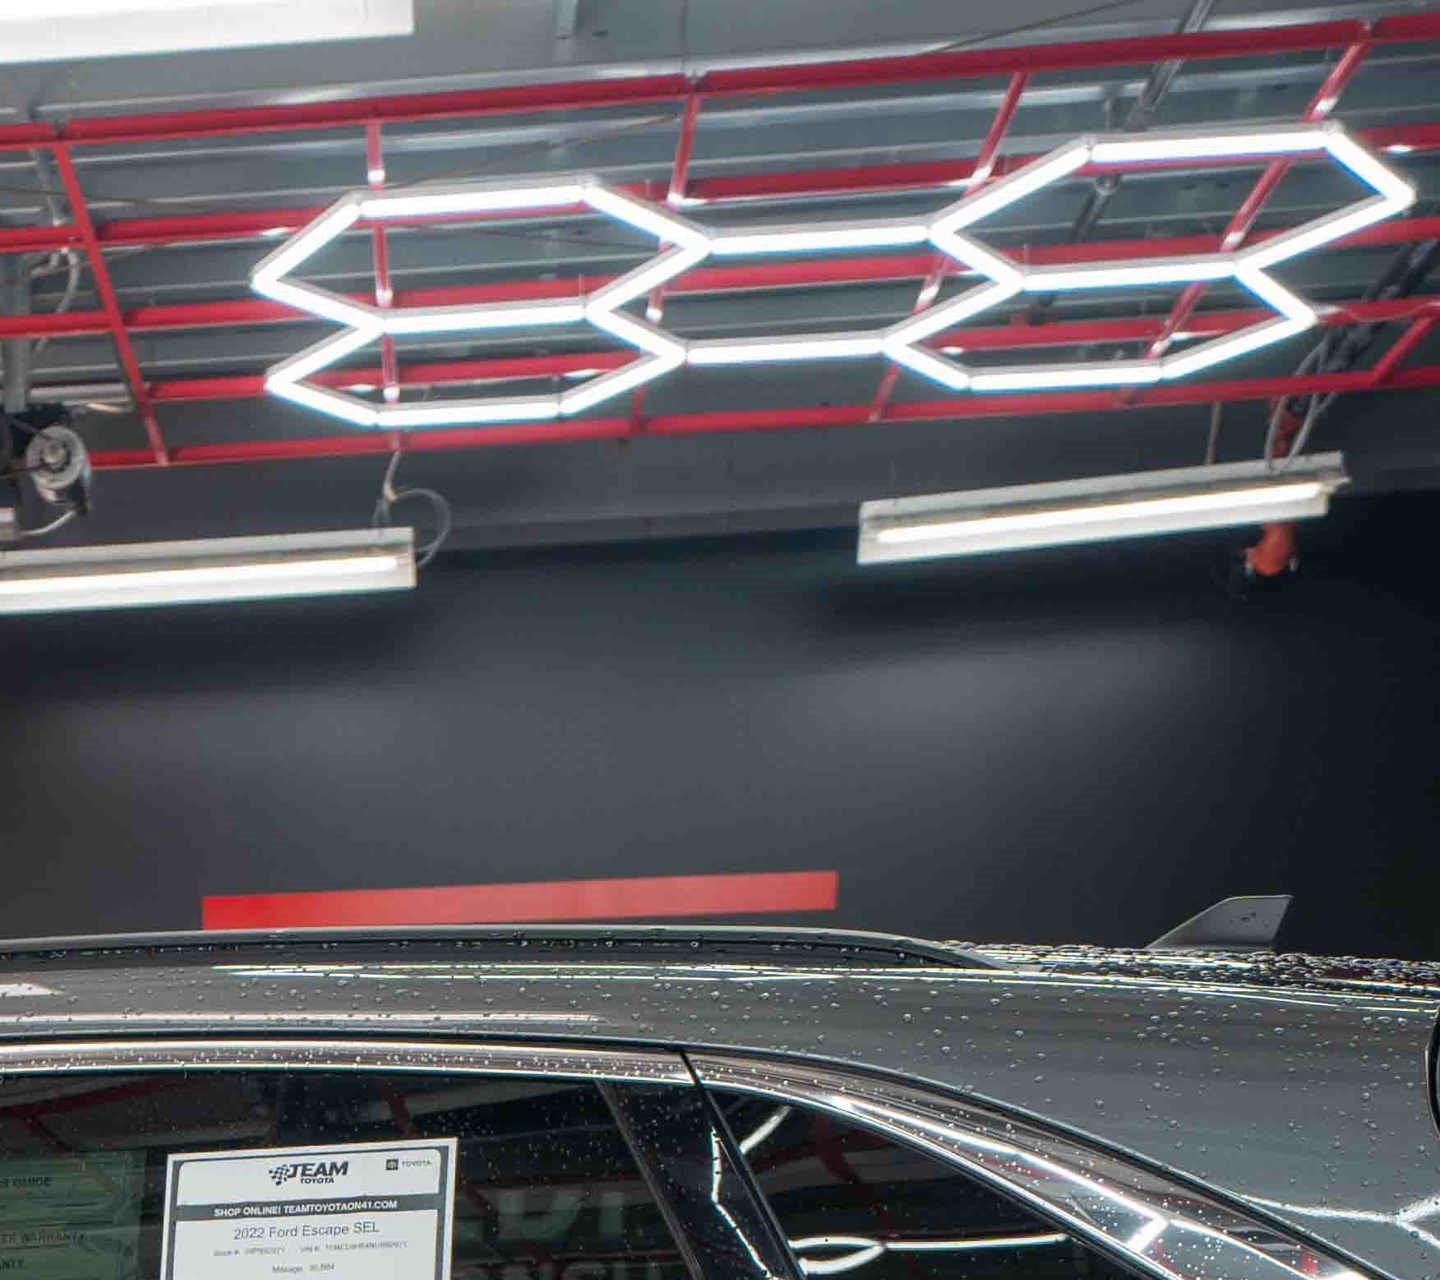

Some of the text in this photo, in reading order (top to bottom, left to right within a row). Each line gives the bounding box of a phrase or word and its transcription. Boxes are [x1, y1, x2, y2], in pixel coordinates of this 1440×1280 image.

[289, 1161, 349, 1178] TEAM
[214, 1200, 397, 1217] SHOP ONLINE! TEAMTOYOTAON41.COM
[233, 1221, 379, 1241] 2022 Ford Escape SEL
